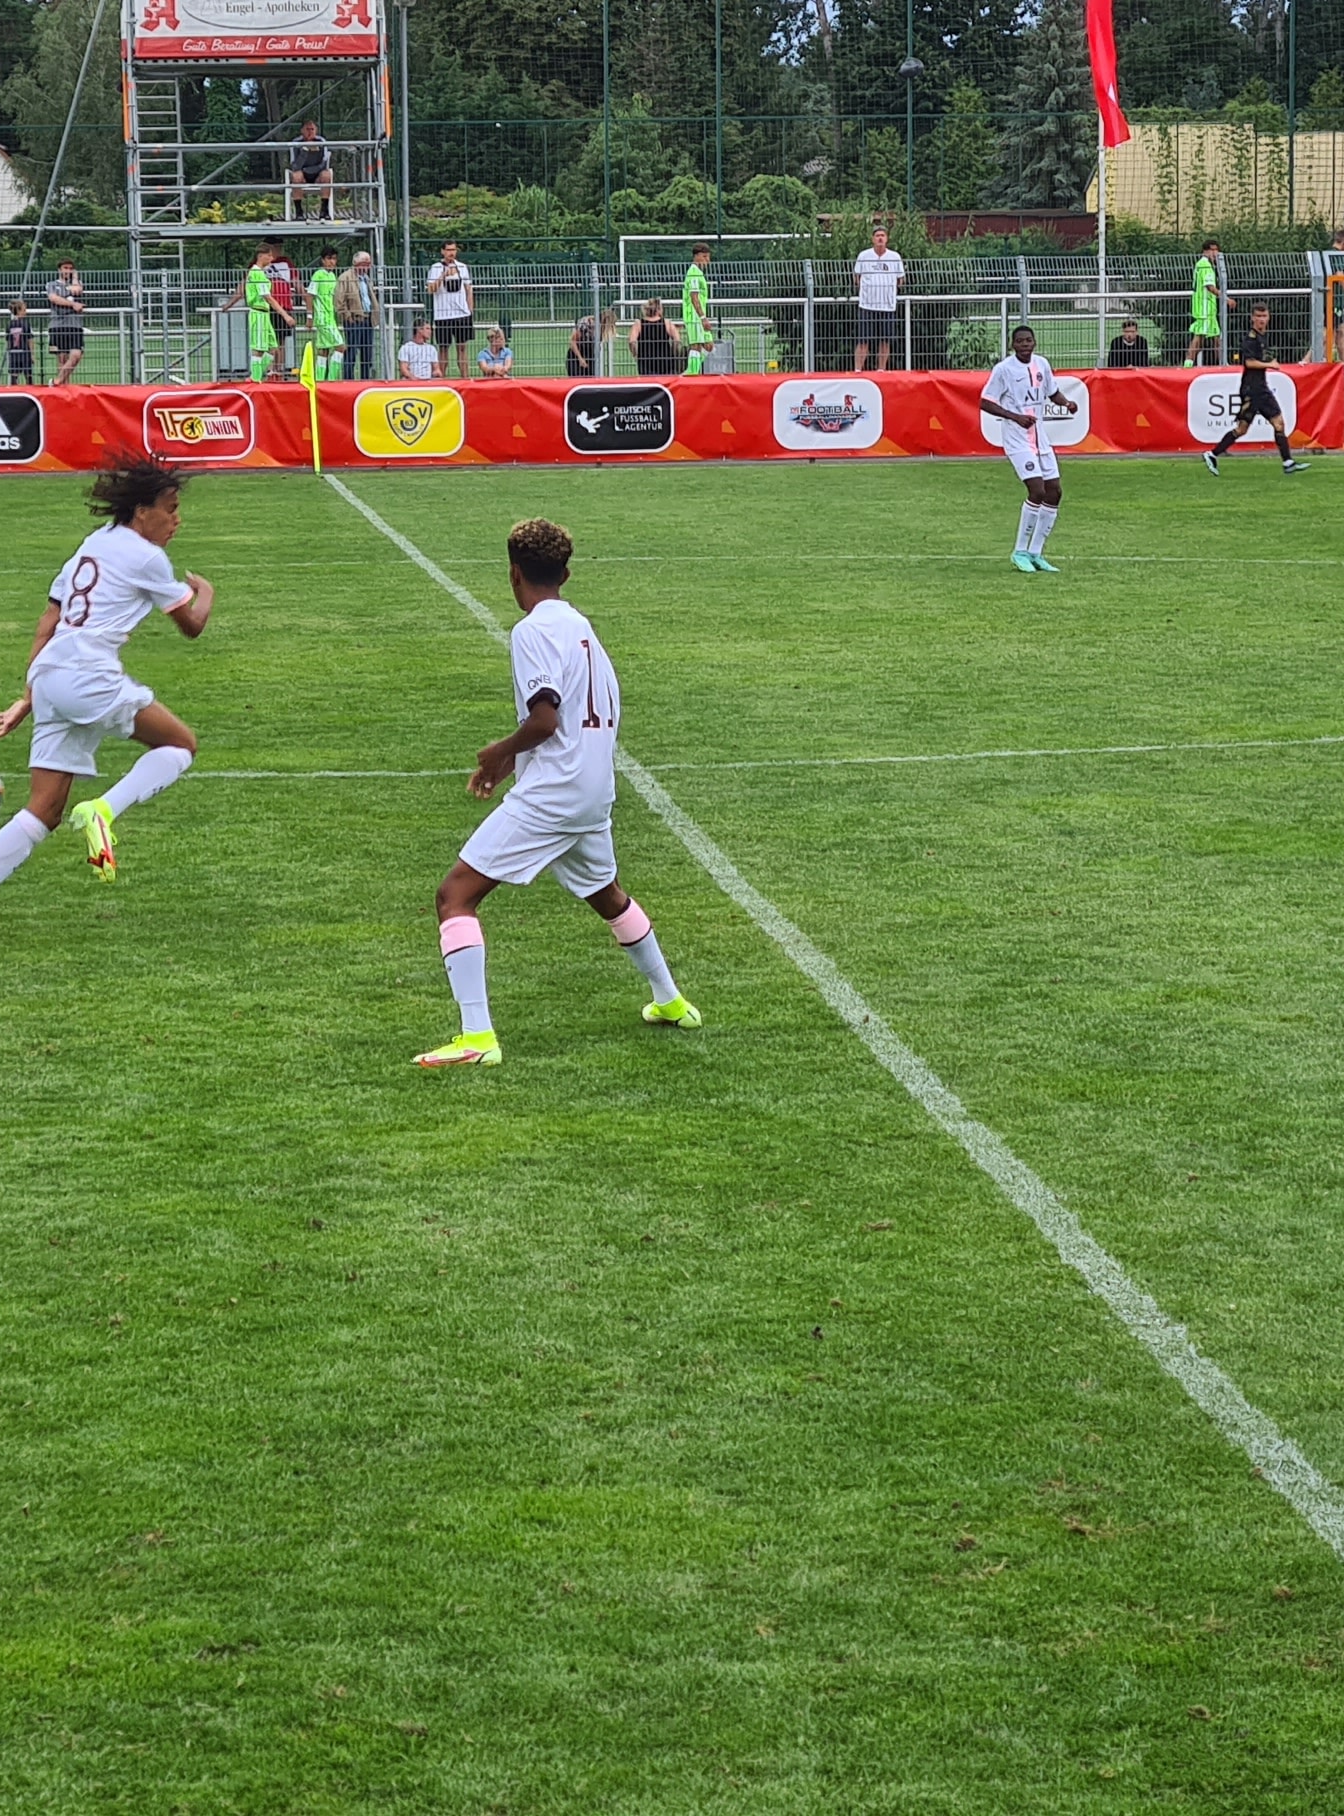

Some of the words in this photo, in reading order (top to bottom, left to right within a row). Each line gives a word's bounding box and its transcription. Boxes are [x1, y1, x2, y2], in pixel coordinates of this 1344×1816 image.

[226, 2, 254, 16] Engel
[265, 1, 320, 15] Apotheken
[614, 406, 652, 415] DEUTSCHE
[620, 414, 658, 423] FUSSBALL
[204, 420, 240, 436] UNION
[624, 423, 663, 432] AGENTUR
[527, 674, 552, 690] QNB
